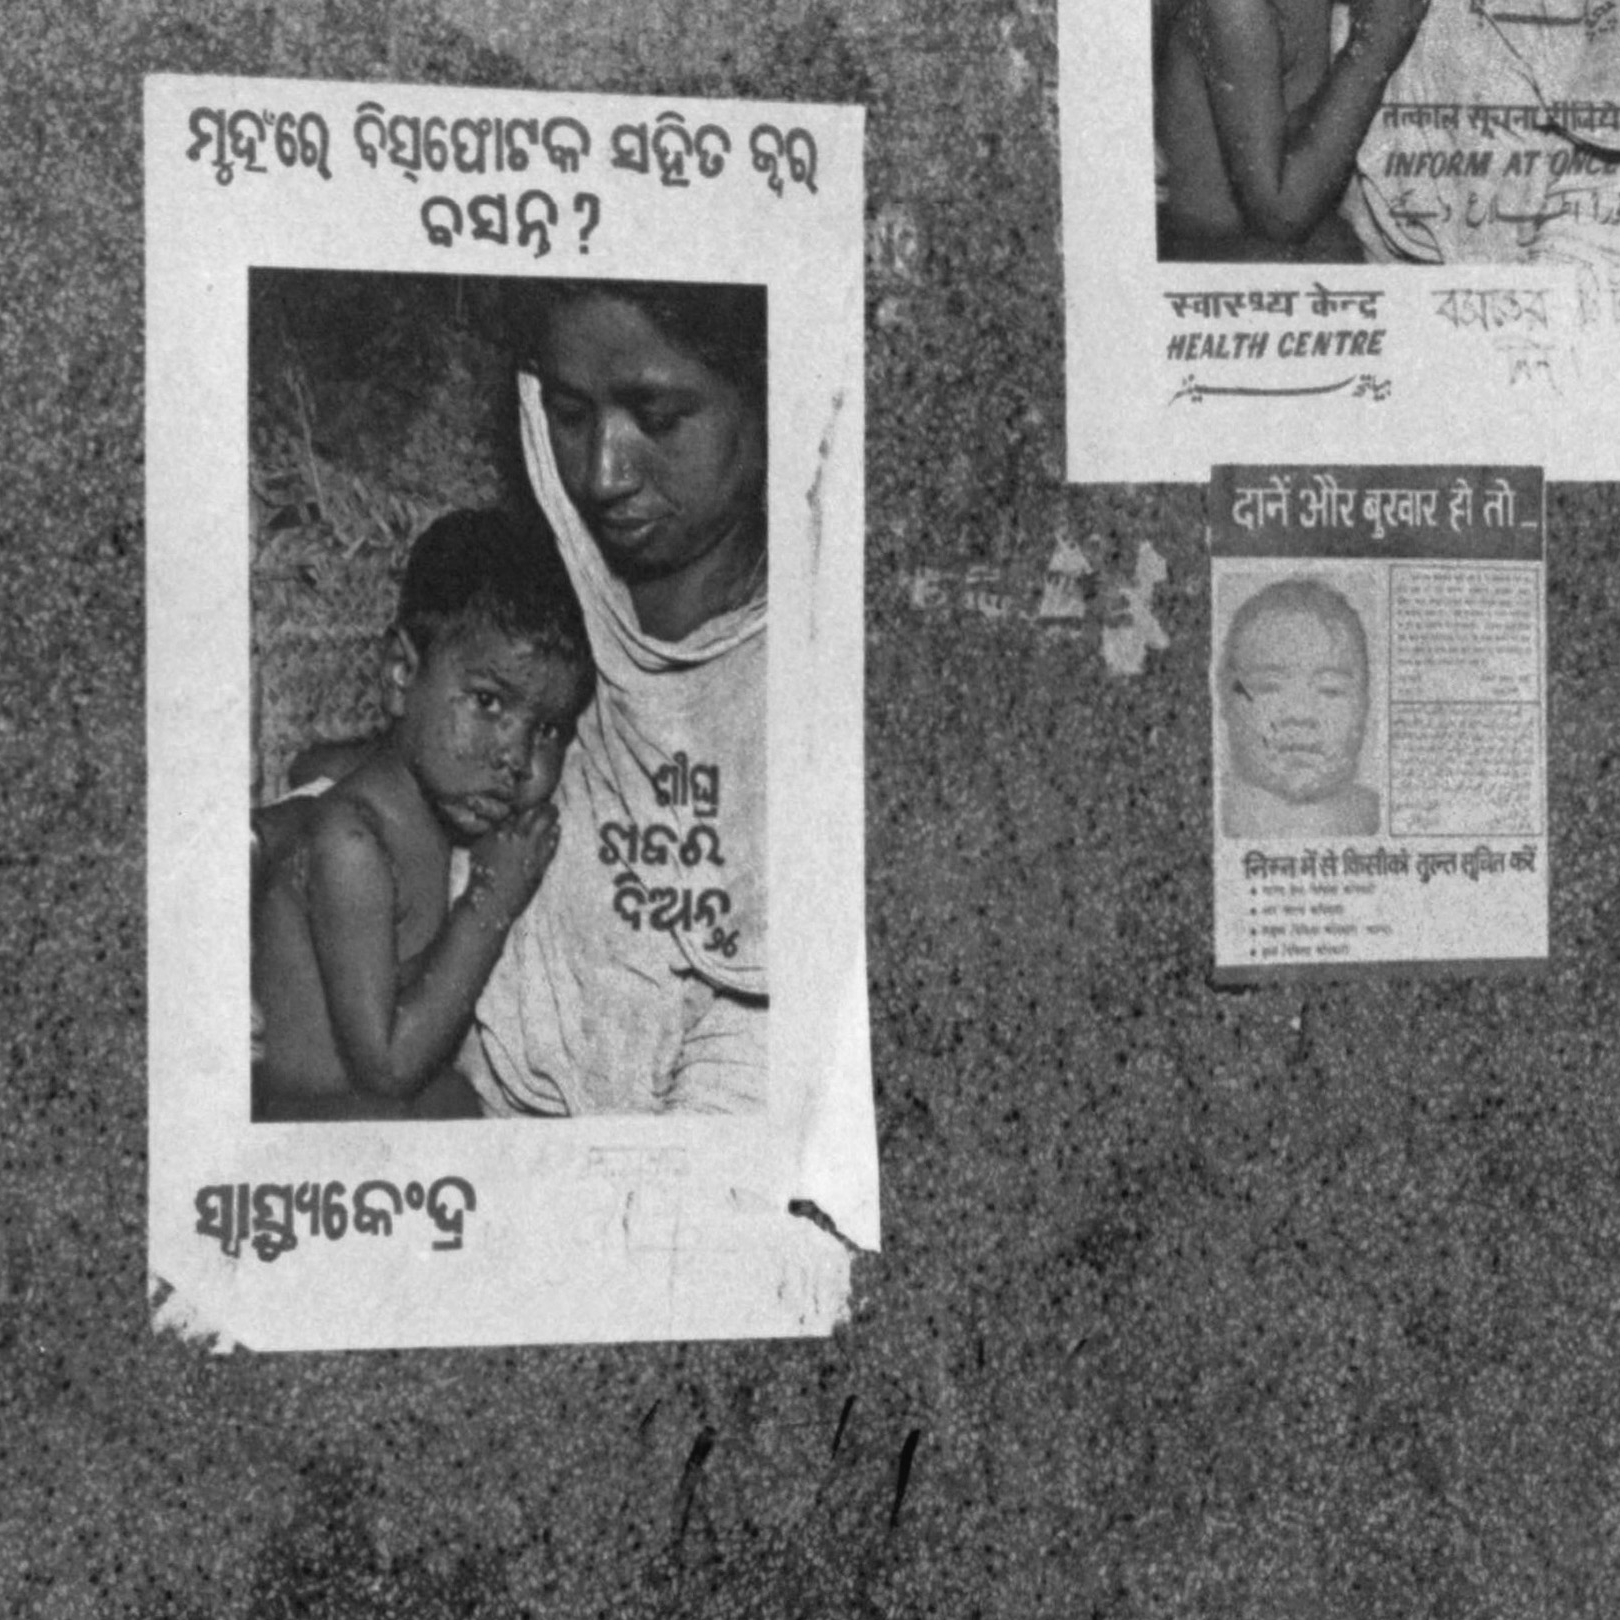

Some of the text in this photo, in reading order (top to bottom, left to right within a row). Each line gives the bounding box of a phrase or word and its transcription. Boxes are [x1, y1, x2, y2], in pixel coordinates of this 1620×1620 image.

[1466, 105, 1541, 140] सूचना
[1385, 149, 1493, 180] INFORM
[1502, 149, 1542, 178] AT
[1166, 329, 1387, 361] HEALTH CENTRE
[1299, 473, 1358, 529] और
